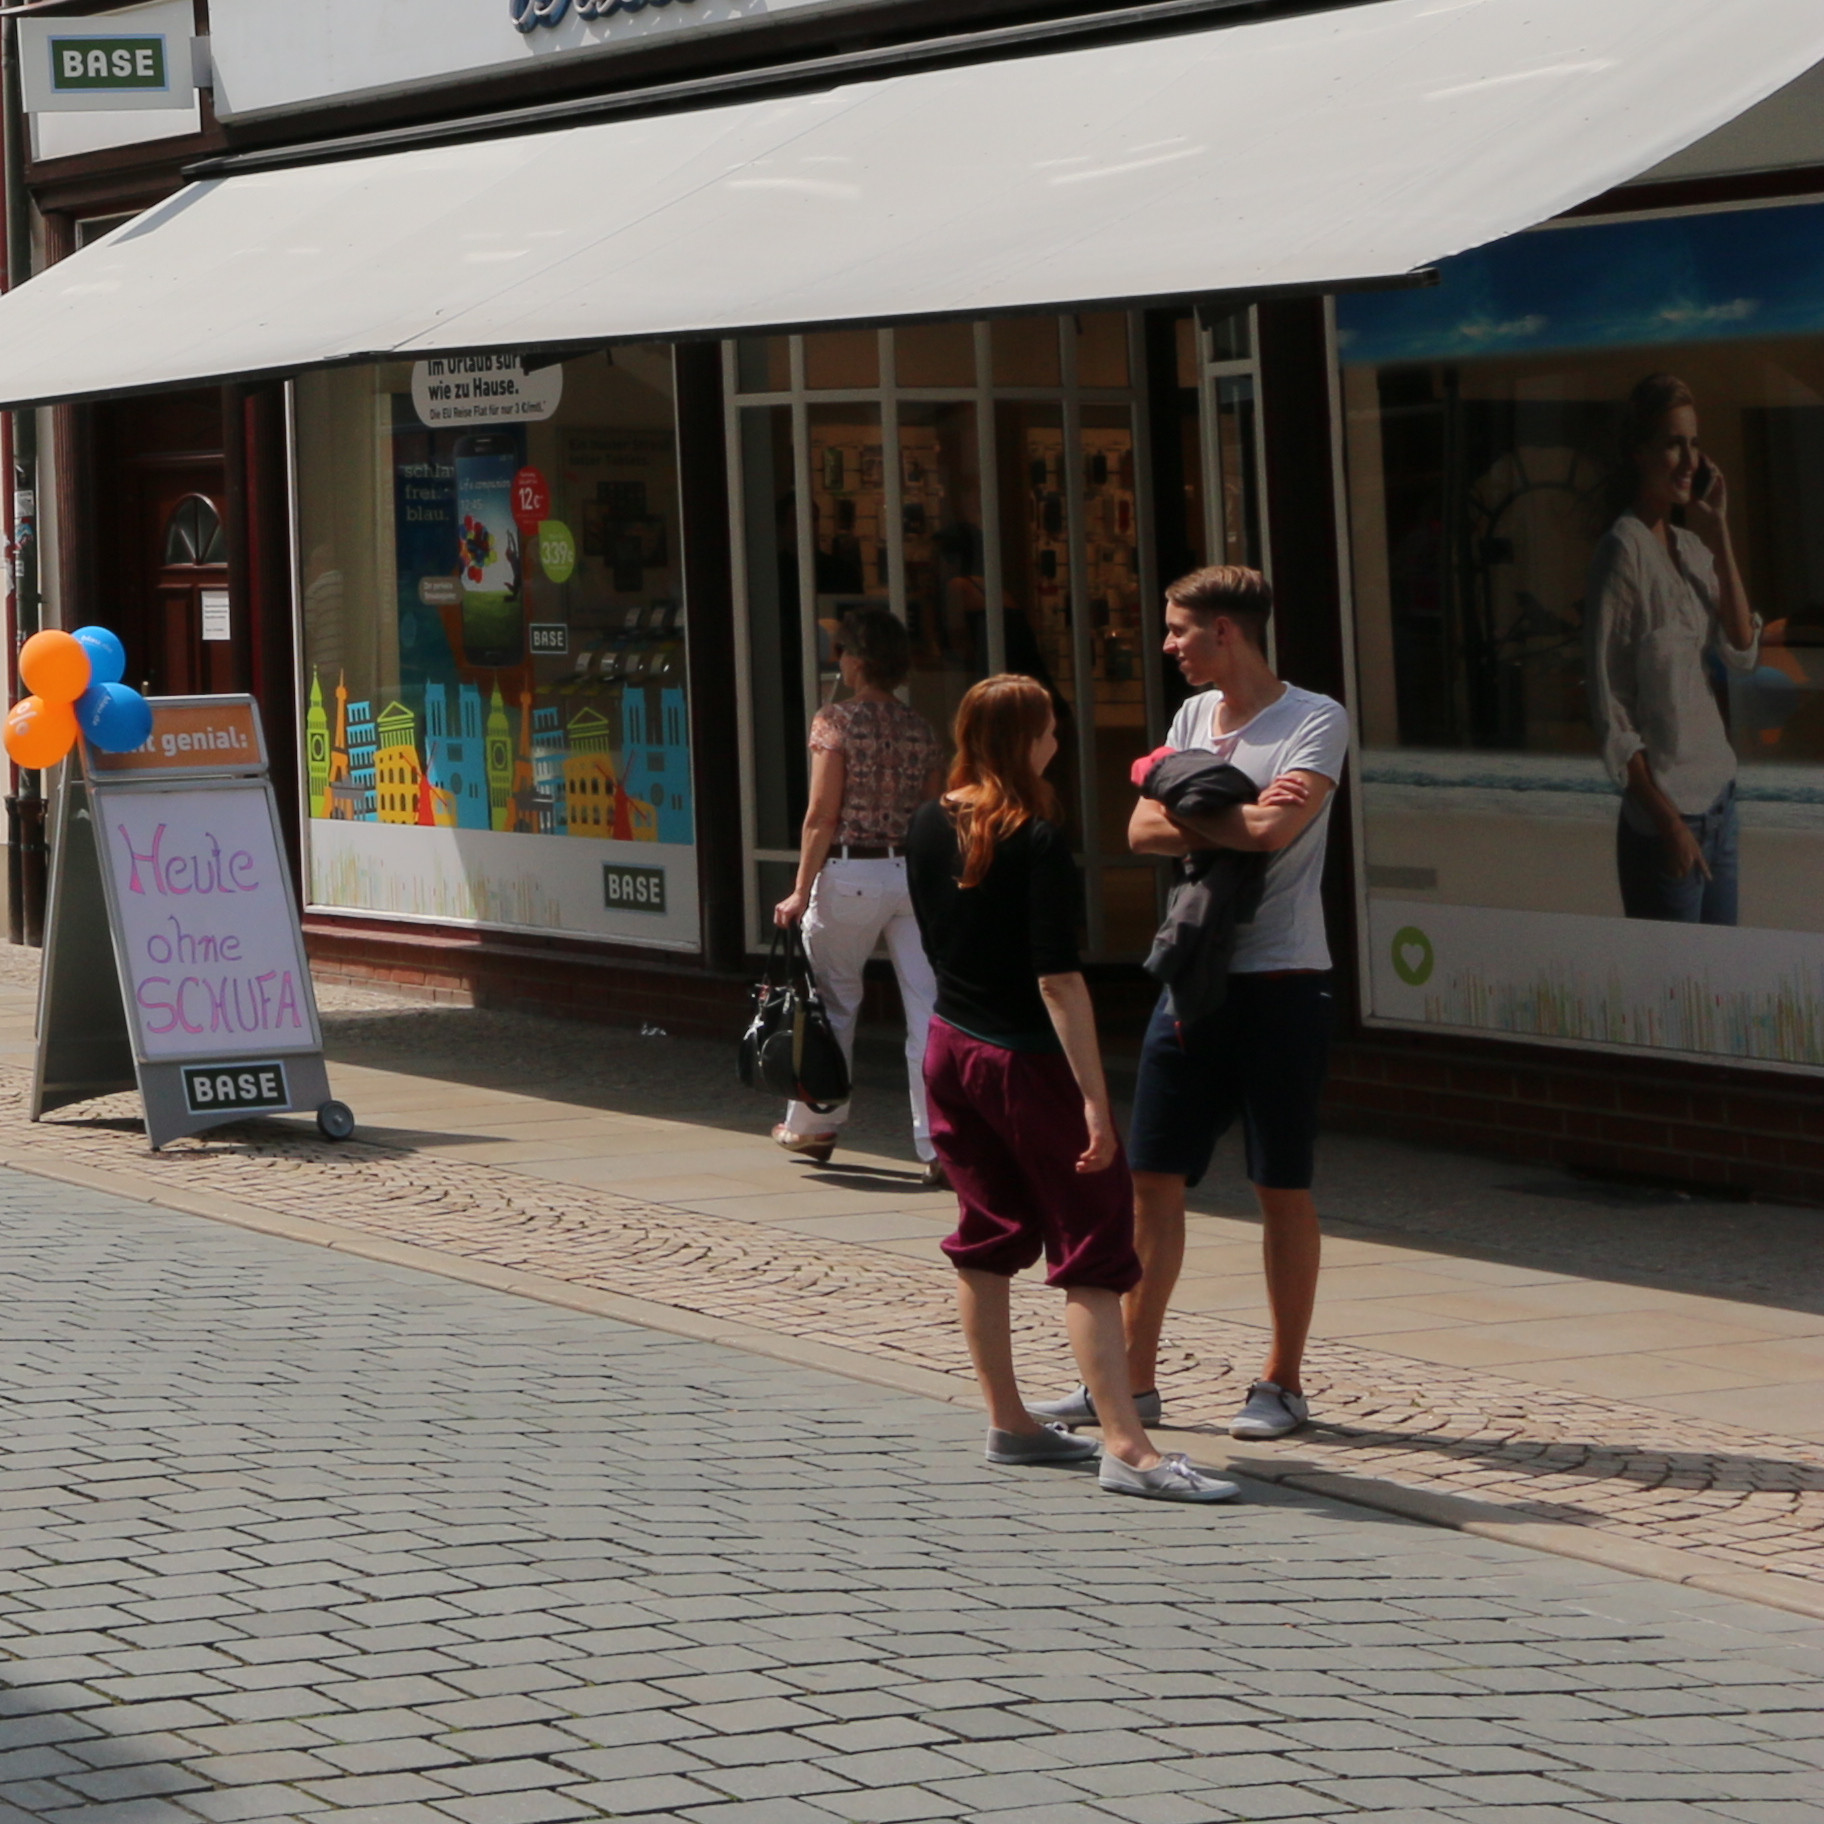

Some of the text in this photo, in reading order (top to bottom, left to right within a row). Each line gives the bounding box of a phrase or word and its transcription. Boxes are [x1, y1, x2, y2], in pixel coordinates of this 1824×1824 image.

[62, 49, 155, 78] BASE
[429, 377, 519, 401] wie zu Hause.
[406, 506, 450, 521] blau.
[533, 630, 565, 647] BASE
[161, 726, 249, 757] genial:
[117, 823, 260, 896] Heute
[608, 873, 661, 904] BASE
[147, 915, 242, 964] ohne
[137, 970, 302, 1034] SCHUFA
[193, 1072, 278, 1102] BASE
